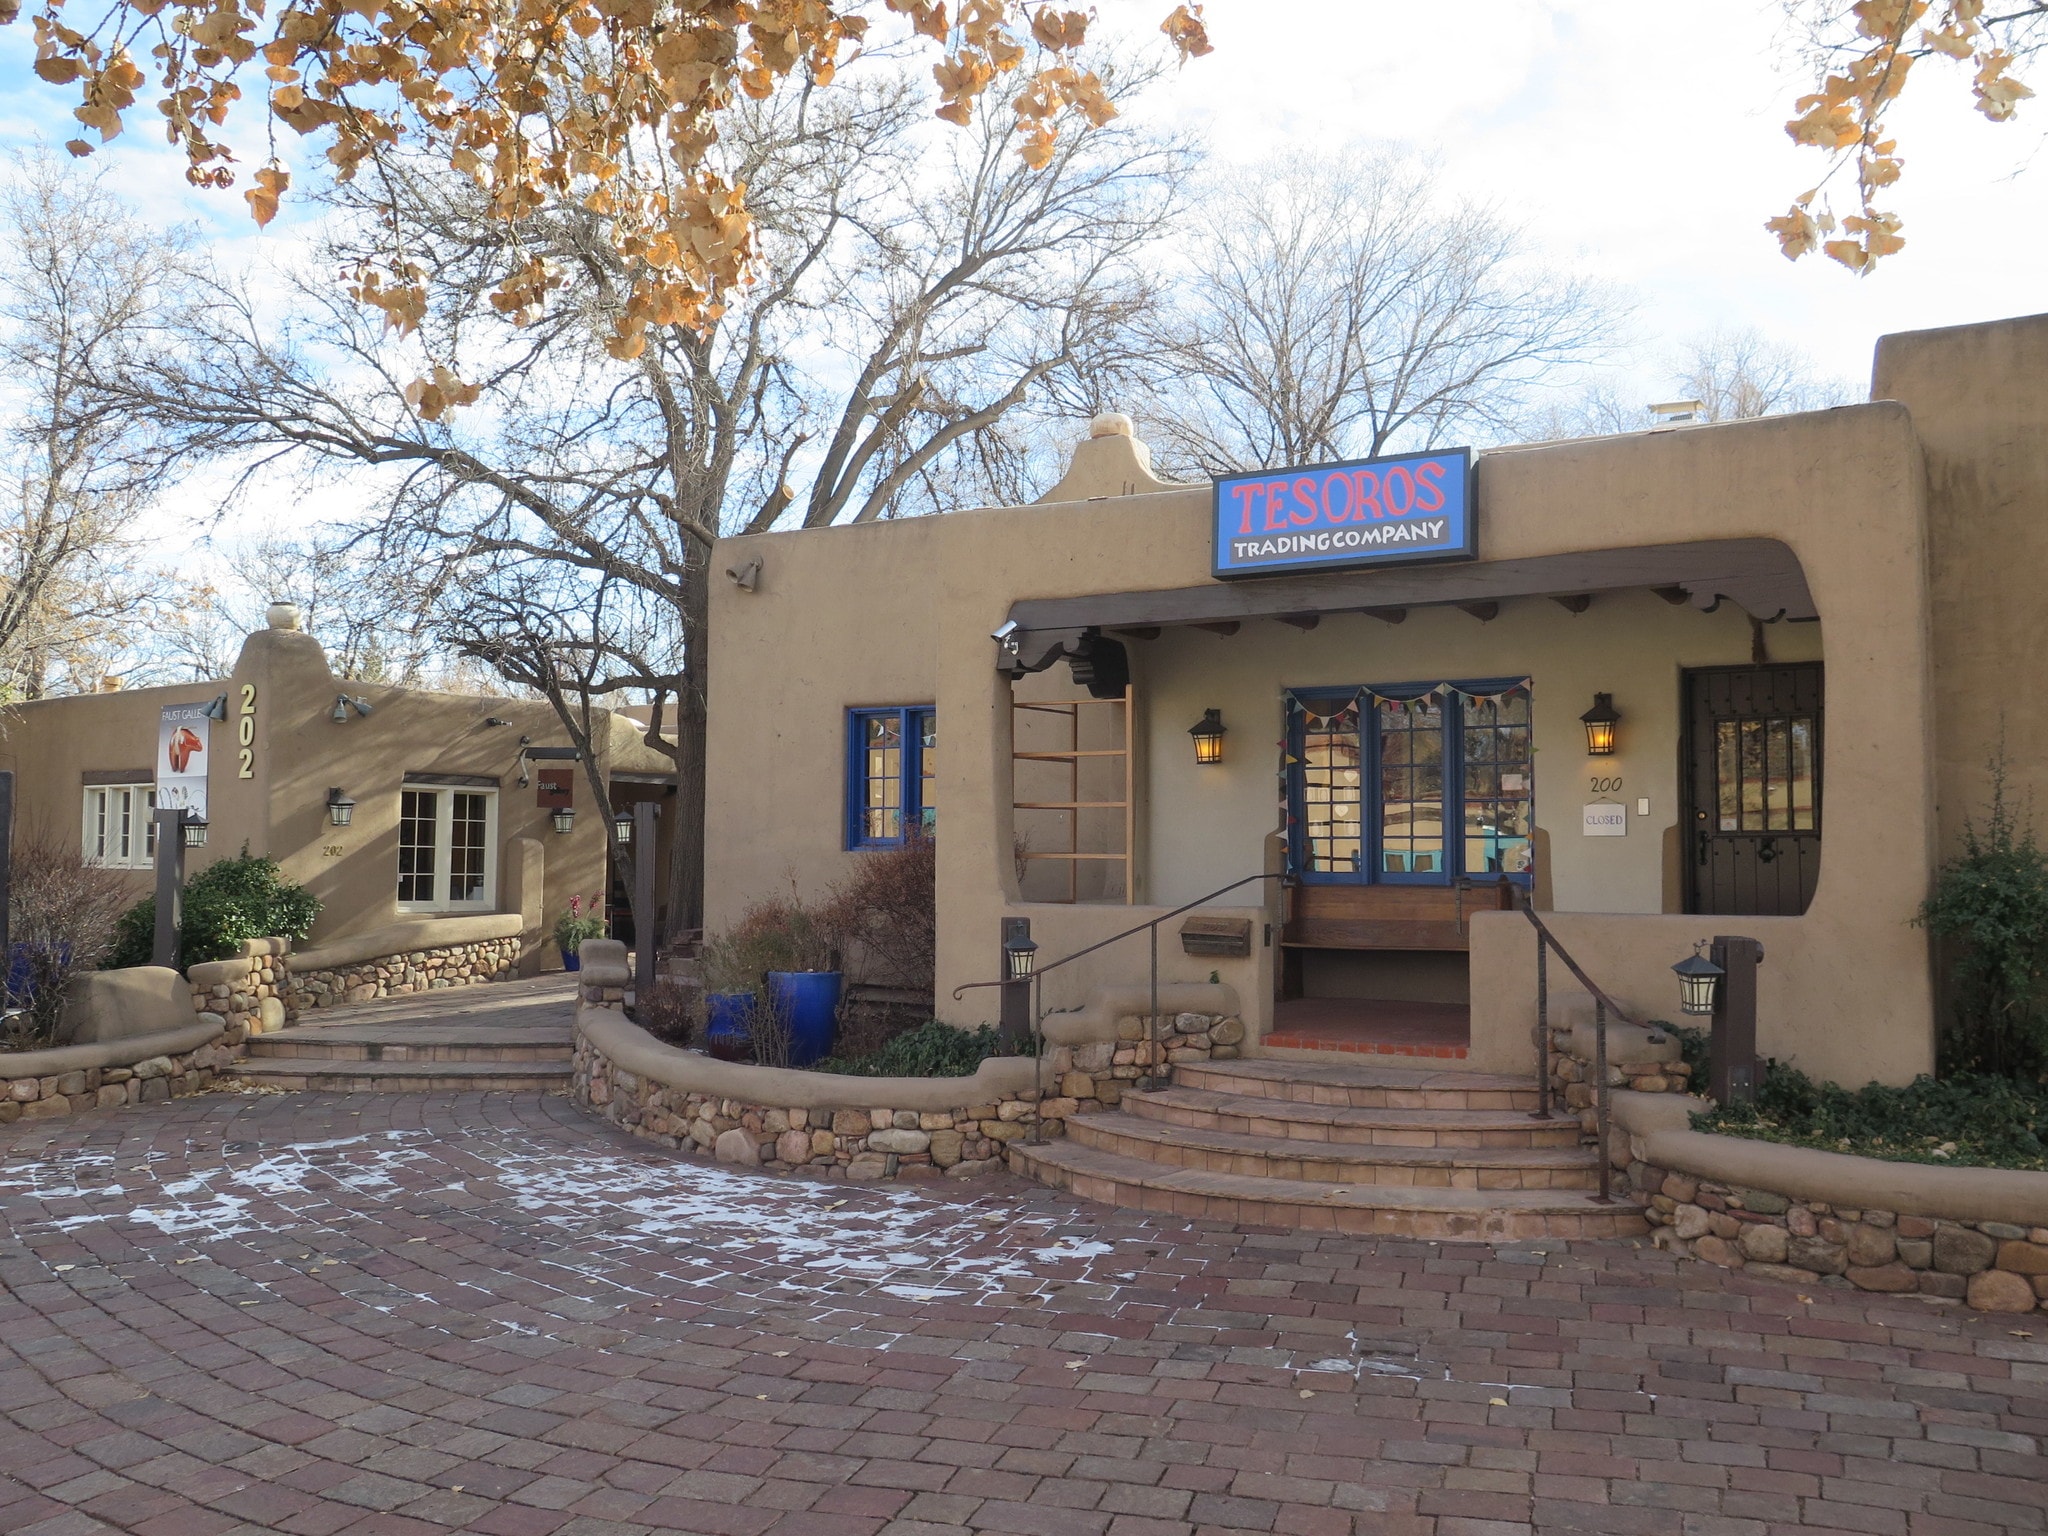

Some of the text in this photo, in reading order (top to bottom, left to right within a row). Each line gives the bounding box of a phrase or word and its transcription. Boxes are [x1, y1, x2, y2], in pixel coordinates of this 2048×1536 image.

[1231, 461, 1447, 534] TESOROS
[1233, 519, 1445, 558] TRADING COMPANY
[161, 708, 206, 721] FAUST GALLE
[238, 683, 257, 780] 202
[1590, 777, 1623, 793] 200
[1585, 814, 1623, 825] CLOSED
[322, 845, 343, 857] 202
